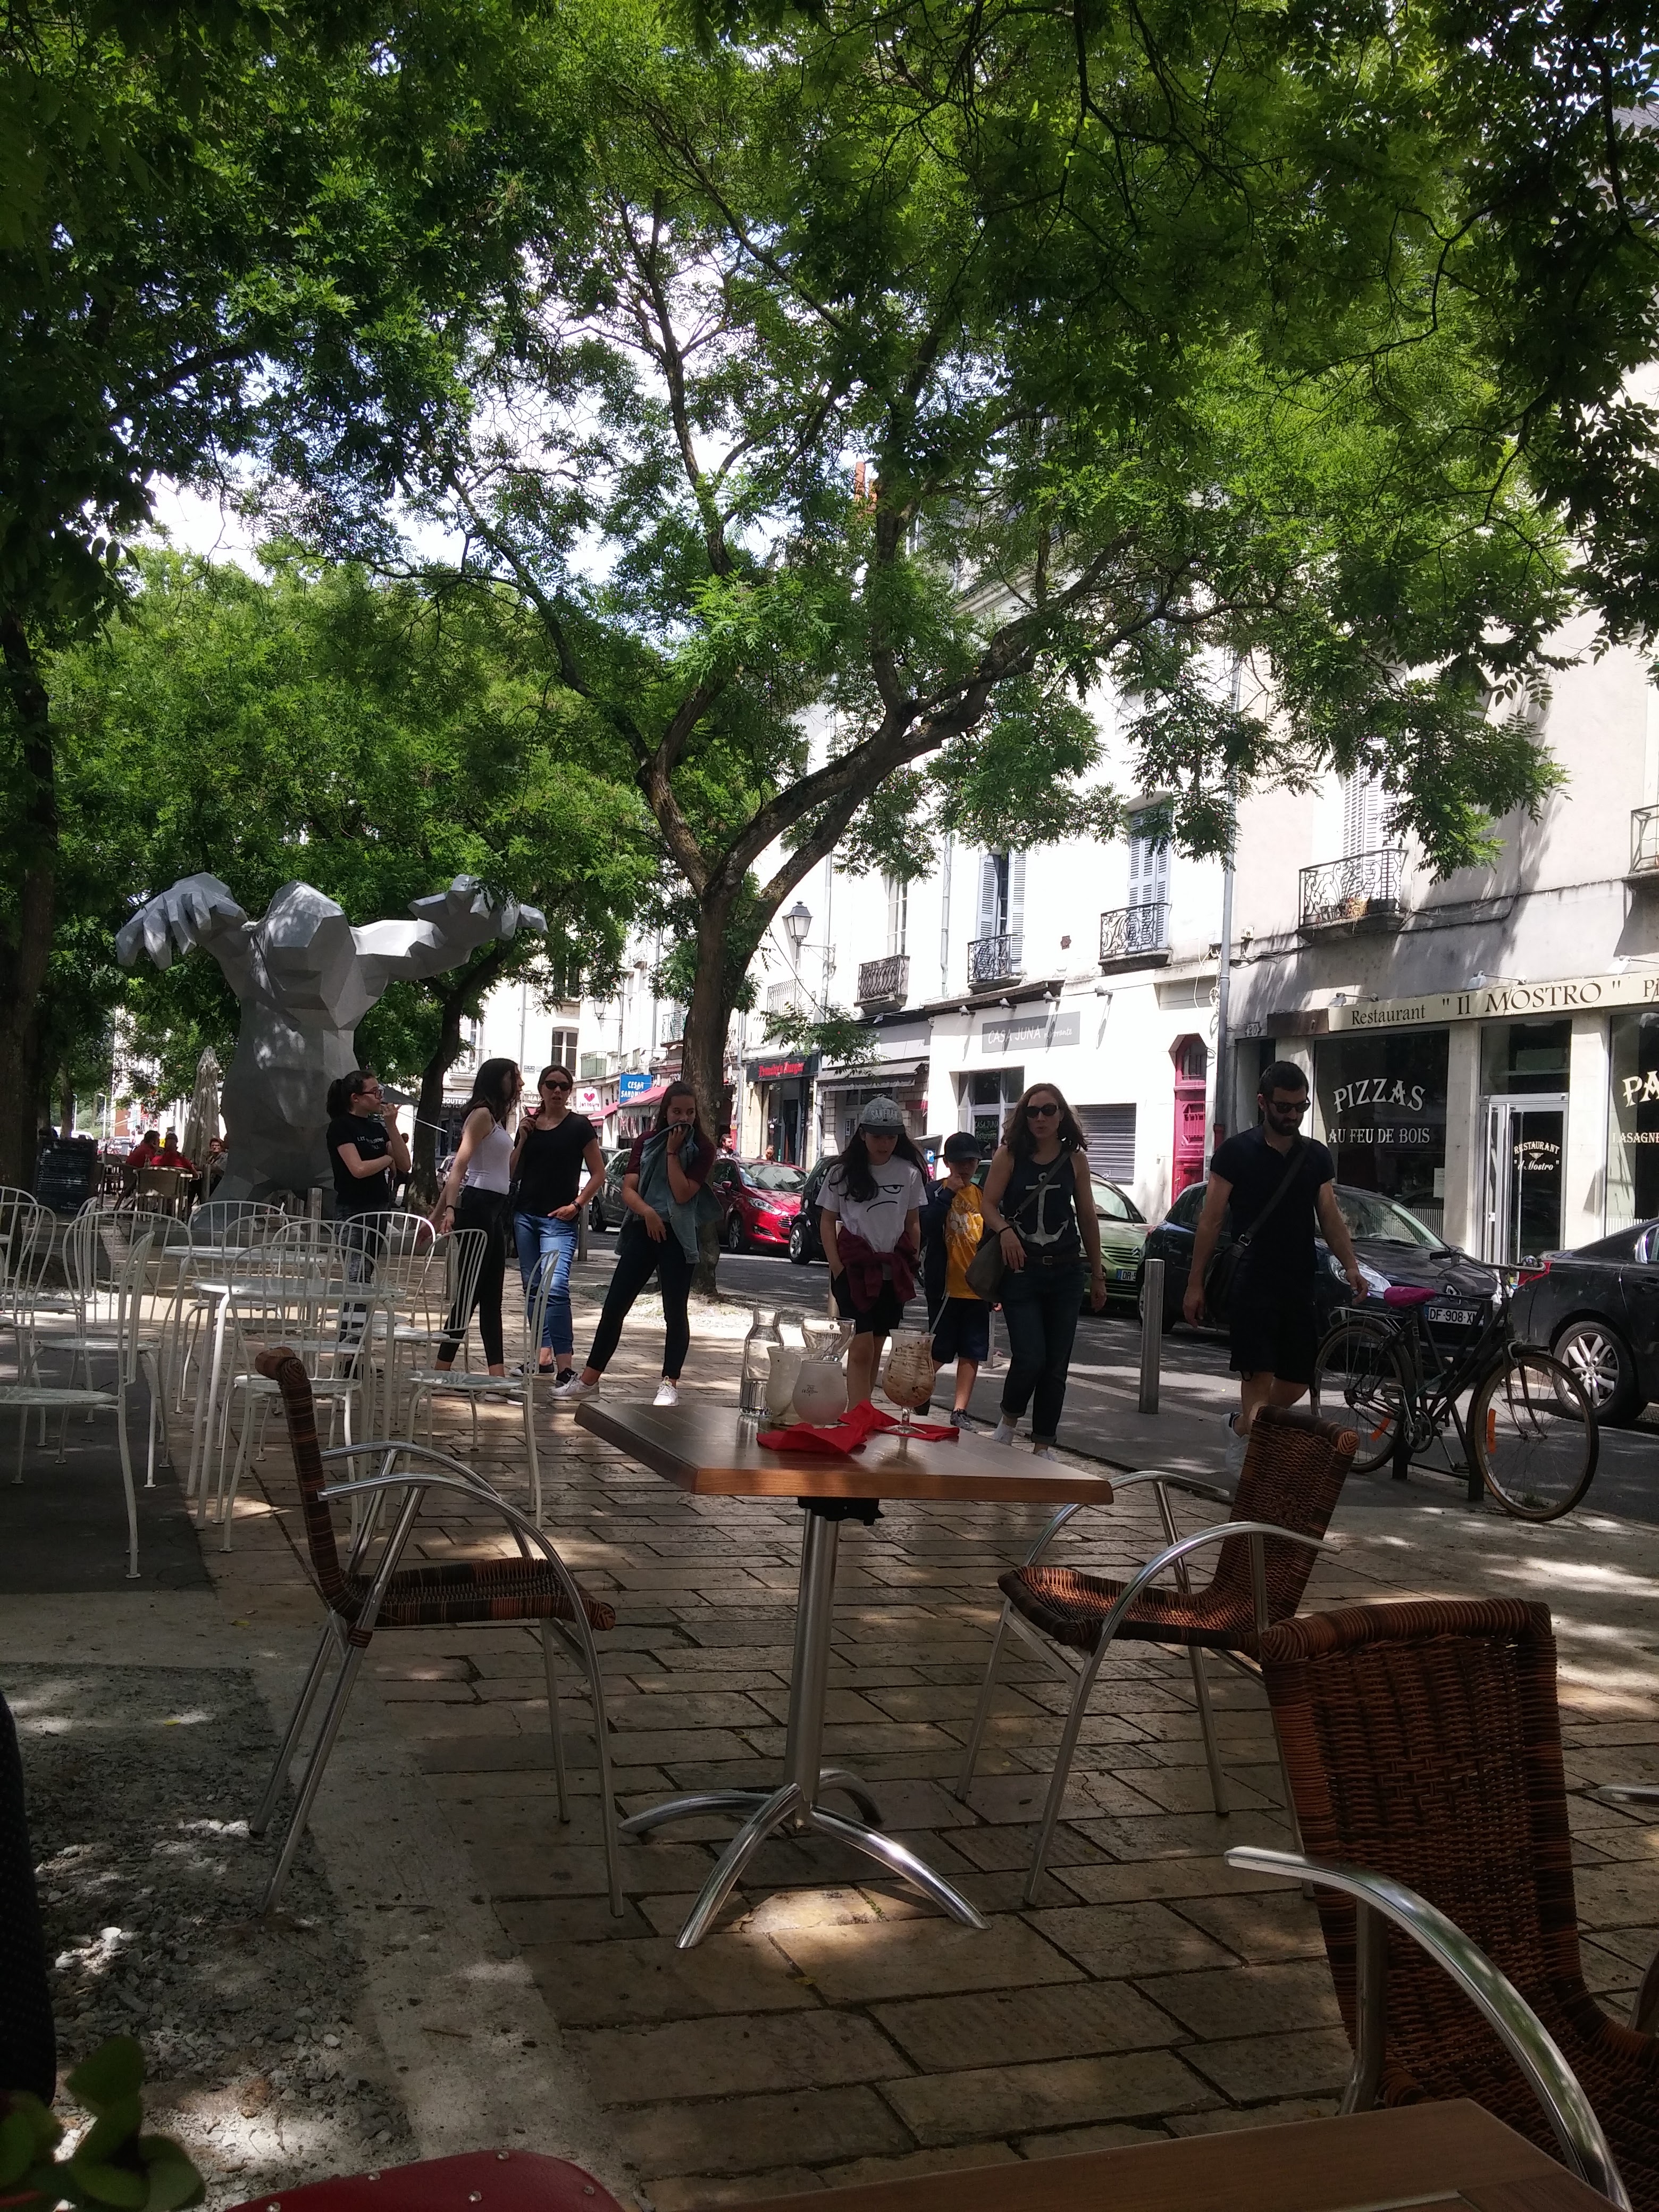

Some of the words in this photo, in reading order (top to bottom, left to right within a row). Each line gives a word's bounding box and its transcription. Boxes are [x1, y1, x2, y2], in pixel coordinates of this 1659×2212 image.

[1351, 1004, 1426, 1025] Restaurant
[988, 1028, 1012, 1044] CASA
[1015, 1025, 1041, 1041] JUNA
[1248, 1025, 1258, 1036] 20
[627, 1081, 644, 1090] CESAR
[1333, 1078, 1426, 1113] PIZZAS
[1328, 1128, 1346, 1143] AU
[1350, 1128, 1374, 1143] FEU
[1377, 1128, 1394, 1143] DE
[1399, 1128, 1430, 1143] BOIS
[1514, 1141, 1560, 1154] RESTAURANT
[927, 1150, 934, 1160] P
